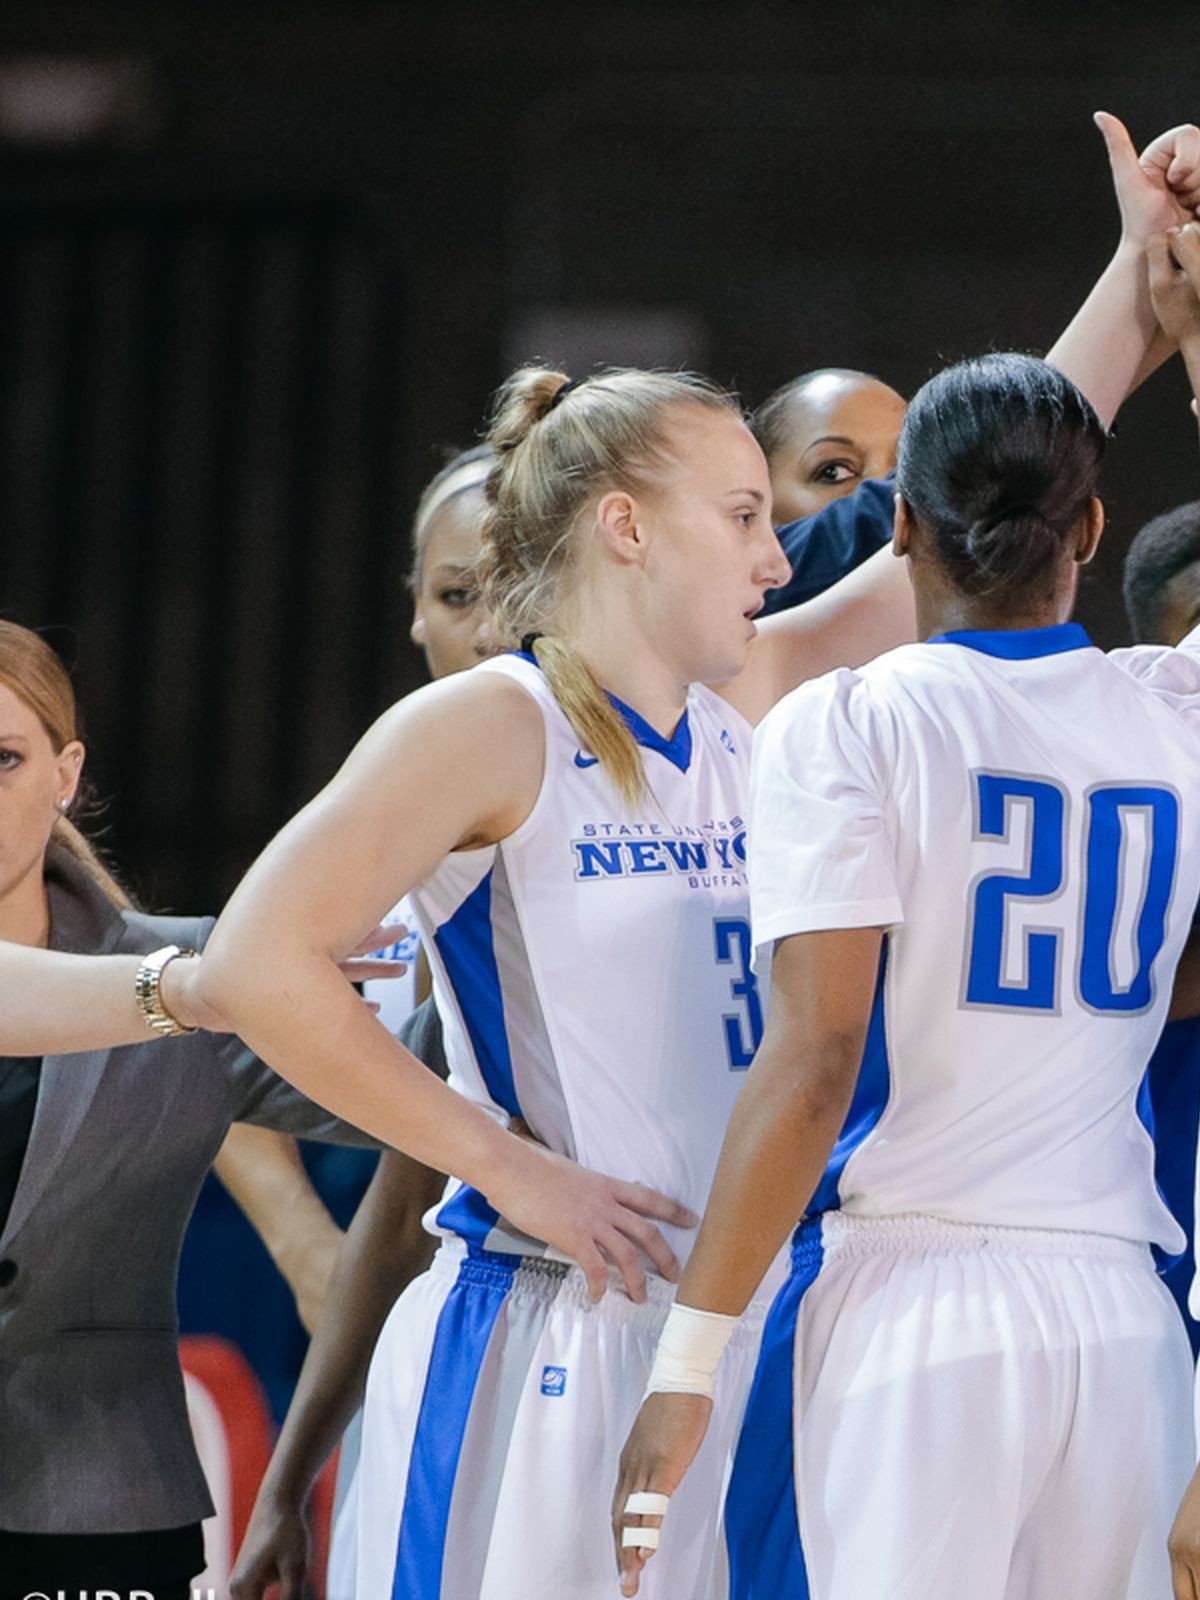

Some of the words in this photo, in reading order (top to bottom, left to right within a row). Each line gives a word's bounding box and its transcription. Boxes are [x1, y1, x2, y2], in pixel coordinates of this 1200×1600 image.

[574, 840, 708, 878] NEW
[583, 823, 661, 837] STATE
[957, 767, 1183, 1019] 20
[713, 915, 765, 1071] 3
